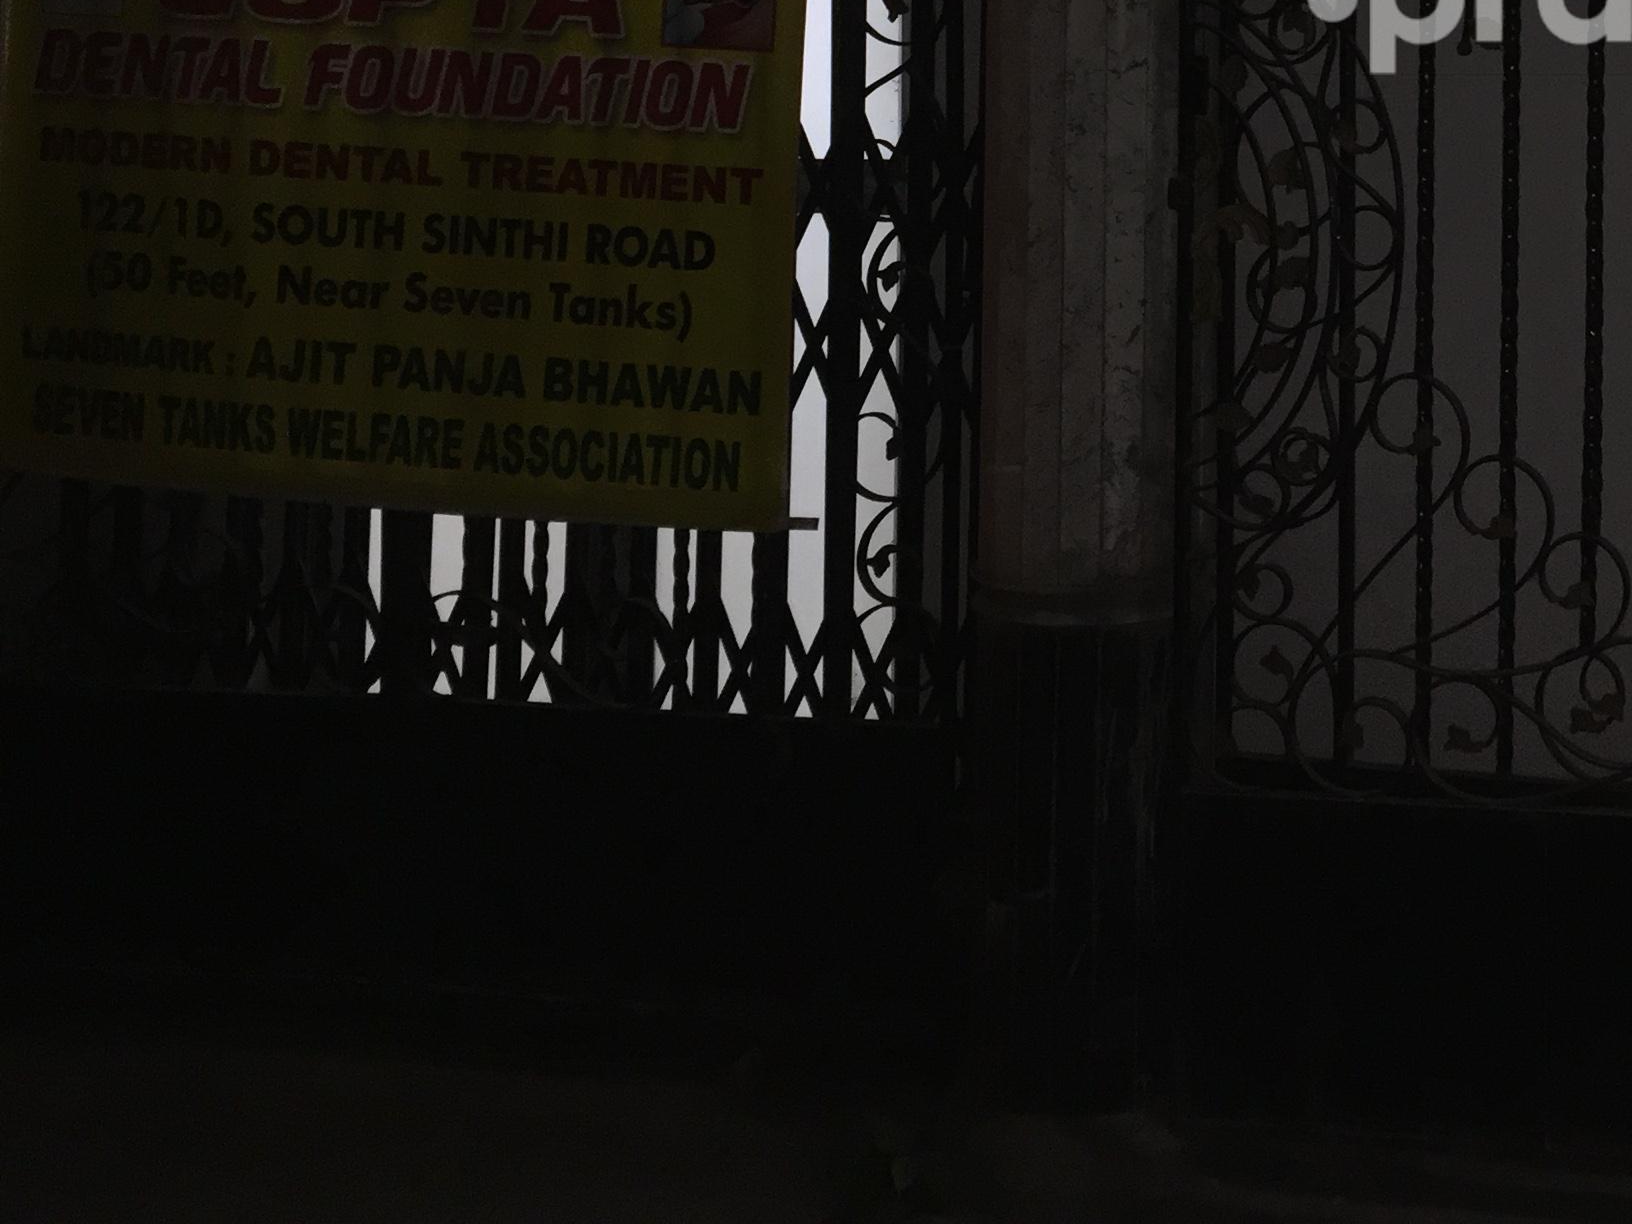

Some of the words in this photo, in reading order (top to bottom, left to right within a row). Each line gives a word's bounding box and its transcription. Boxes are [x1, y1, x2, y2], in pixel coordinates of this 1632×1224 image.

[33, 27, 282, 111] DENTAL
[304, 43, 753, 134] FOUNDATION
[38, 126, 231, 173] MODERN
[250, 140, 442, 189] DENTAL
[461, 151, 764, 205] TREATMENT
[251, 202, 404, 253] SOUTH
[422, 212, 569, 264] SINTHI
[585, 224, 716, 272] ROAD
[86, 250, 152, 300] (50
[167, 255, 256, 308] Feet,
[277, 265, 388, 312] Near
[405, 272, 531, 321] Seven
[551, 282, 693, 342] Tanks)
[21, 323, 214, 376] LANDMARK
[246, 336, 356, 388] AJIT
[372, 345, 527, 400] PANJA
[543, 356, 762, 416] BHAWAN
[31, 381, 145, 440] SEVEN
[159, 393, 276, 456] TANKS
[288, 409, 464, 472] WELFARE
[474, 427, 741, 492] ASSOCIATION
